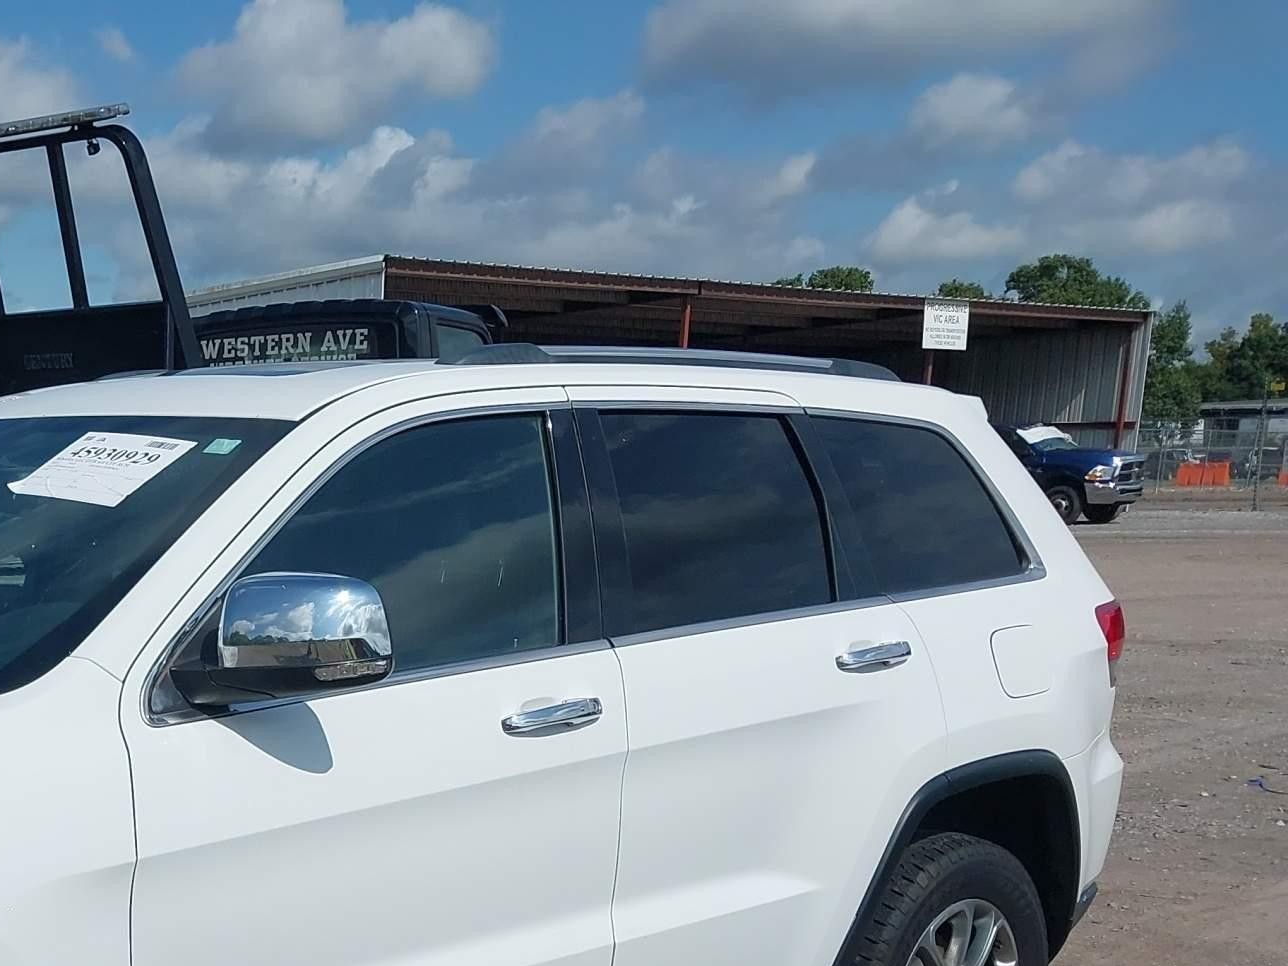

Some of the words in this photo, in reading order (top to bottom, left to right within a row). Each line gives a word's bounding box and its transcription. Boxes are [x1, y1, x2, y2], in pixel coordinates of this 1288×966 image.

[926, 302, 968, 314] PROGRESSIVE
[944, 315, 960, 325] AREA
[200, 332, 312, 360] WESTERN
[320, 328, 369, 352] AVE
[70, 445, 162, 466] 45930929
